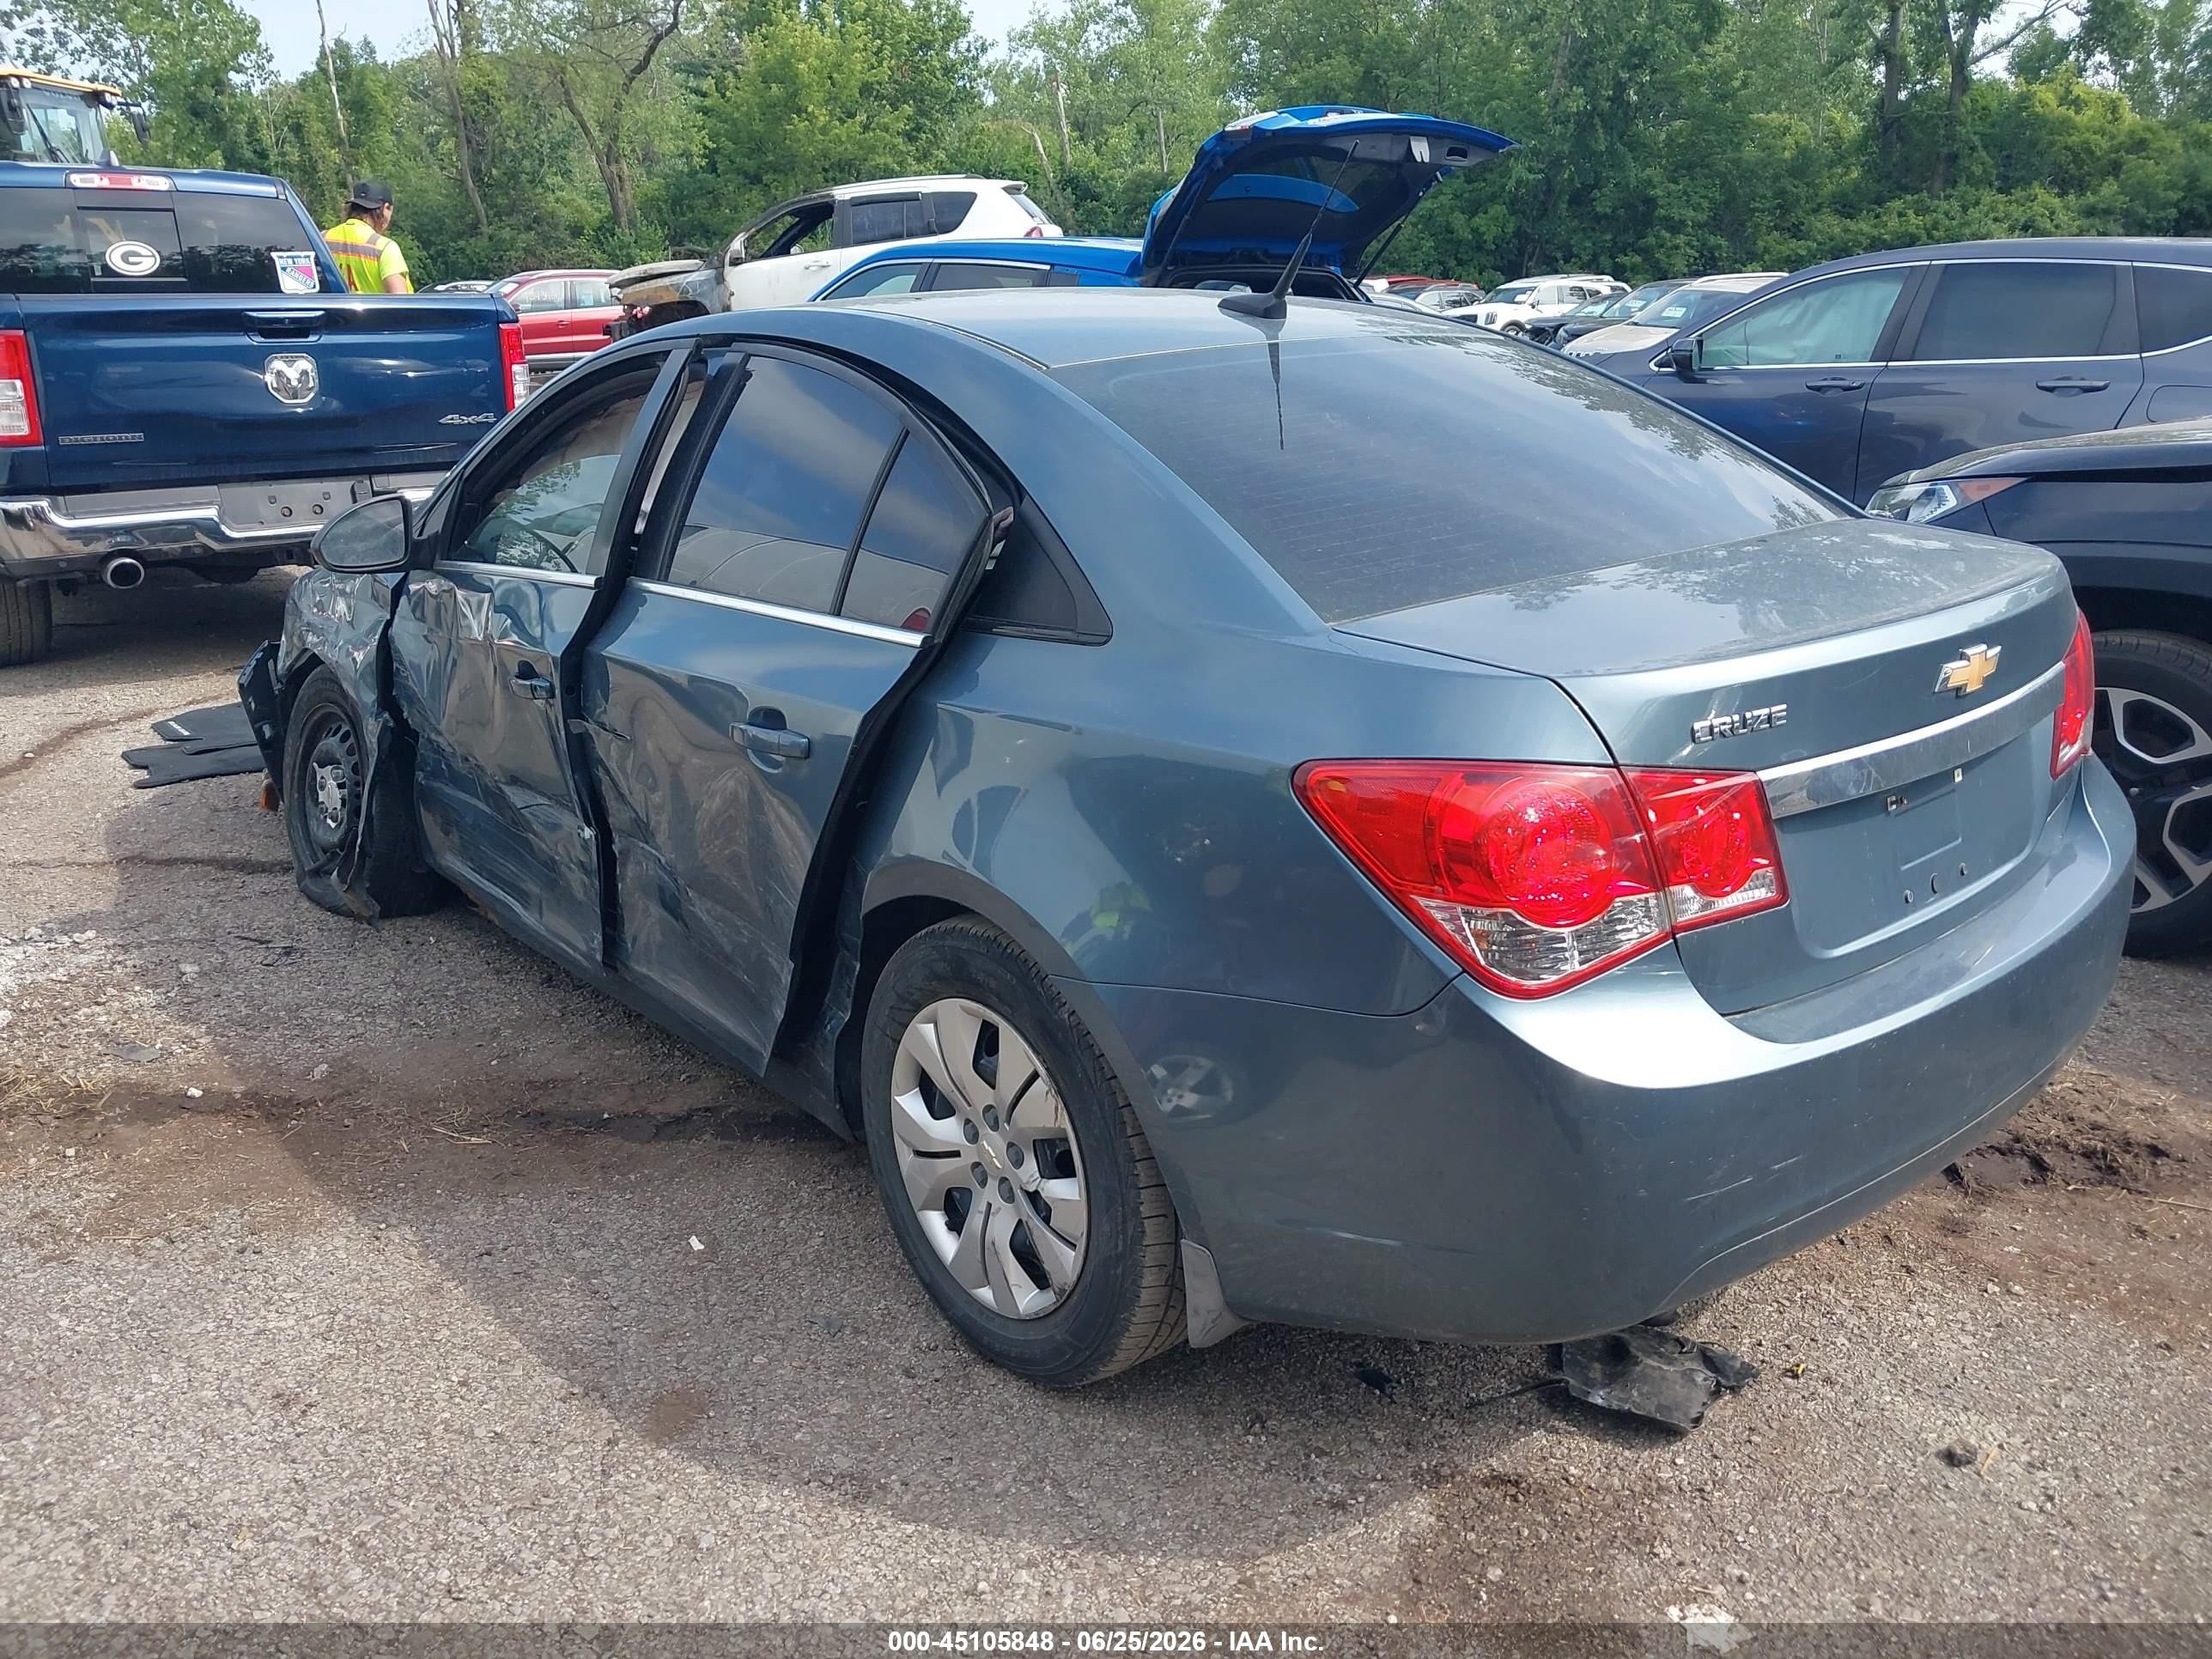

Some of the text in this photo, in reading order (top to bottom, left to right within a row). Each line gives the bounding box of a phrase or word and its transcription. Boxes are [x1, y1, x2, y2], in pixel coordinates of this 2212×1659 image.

[108, 242, 157, 274] G
[285, 267, 315, 289] RANGERS
[1690, 703, 1788, 744] CRUZE
